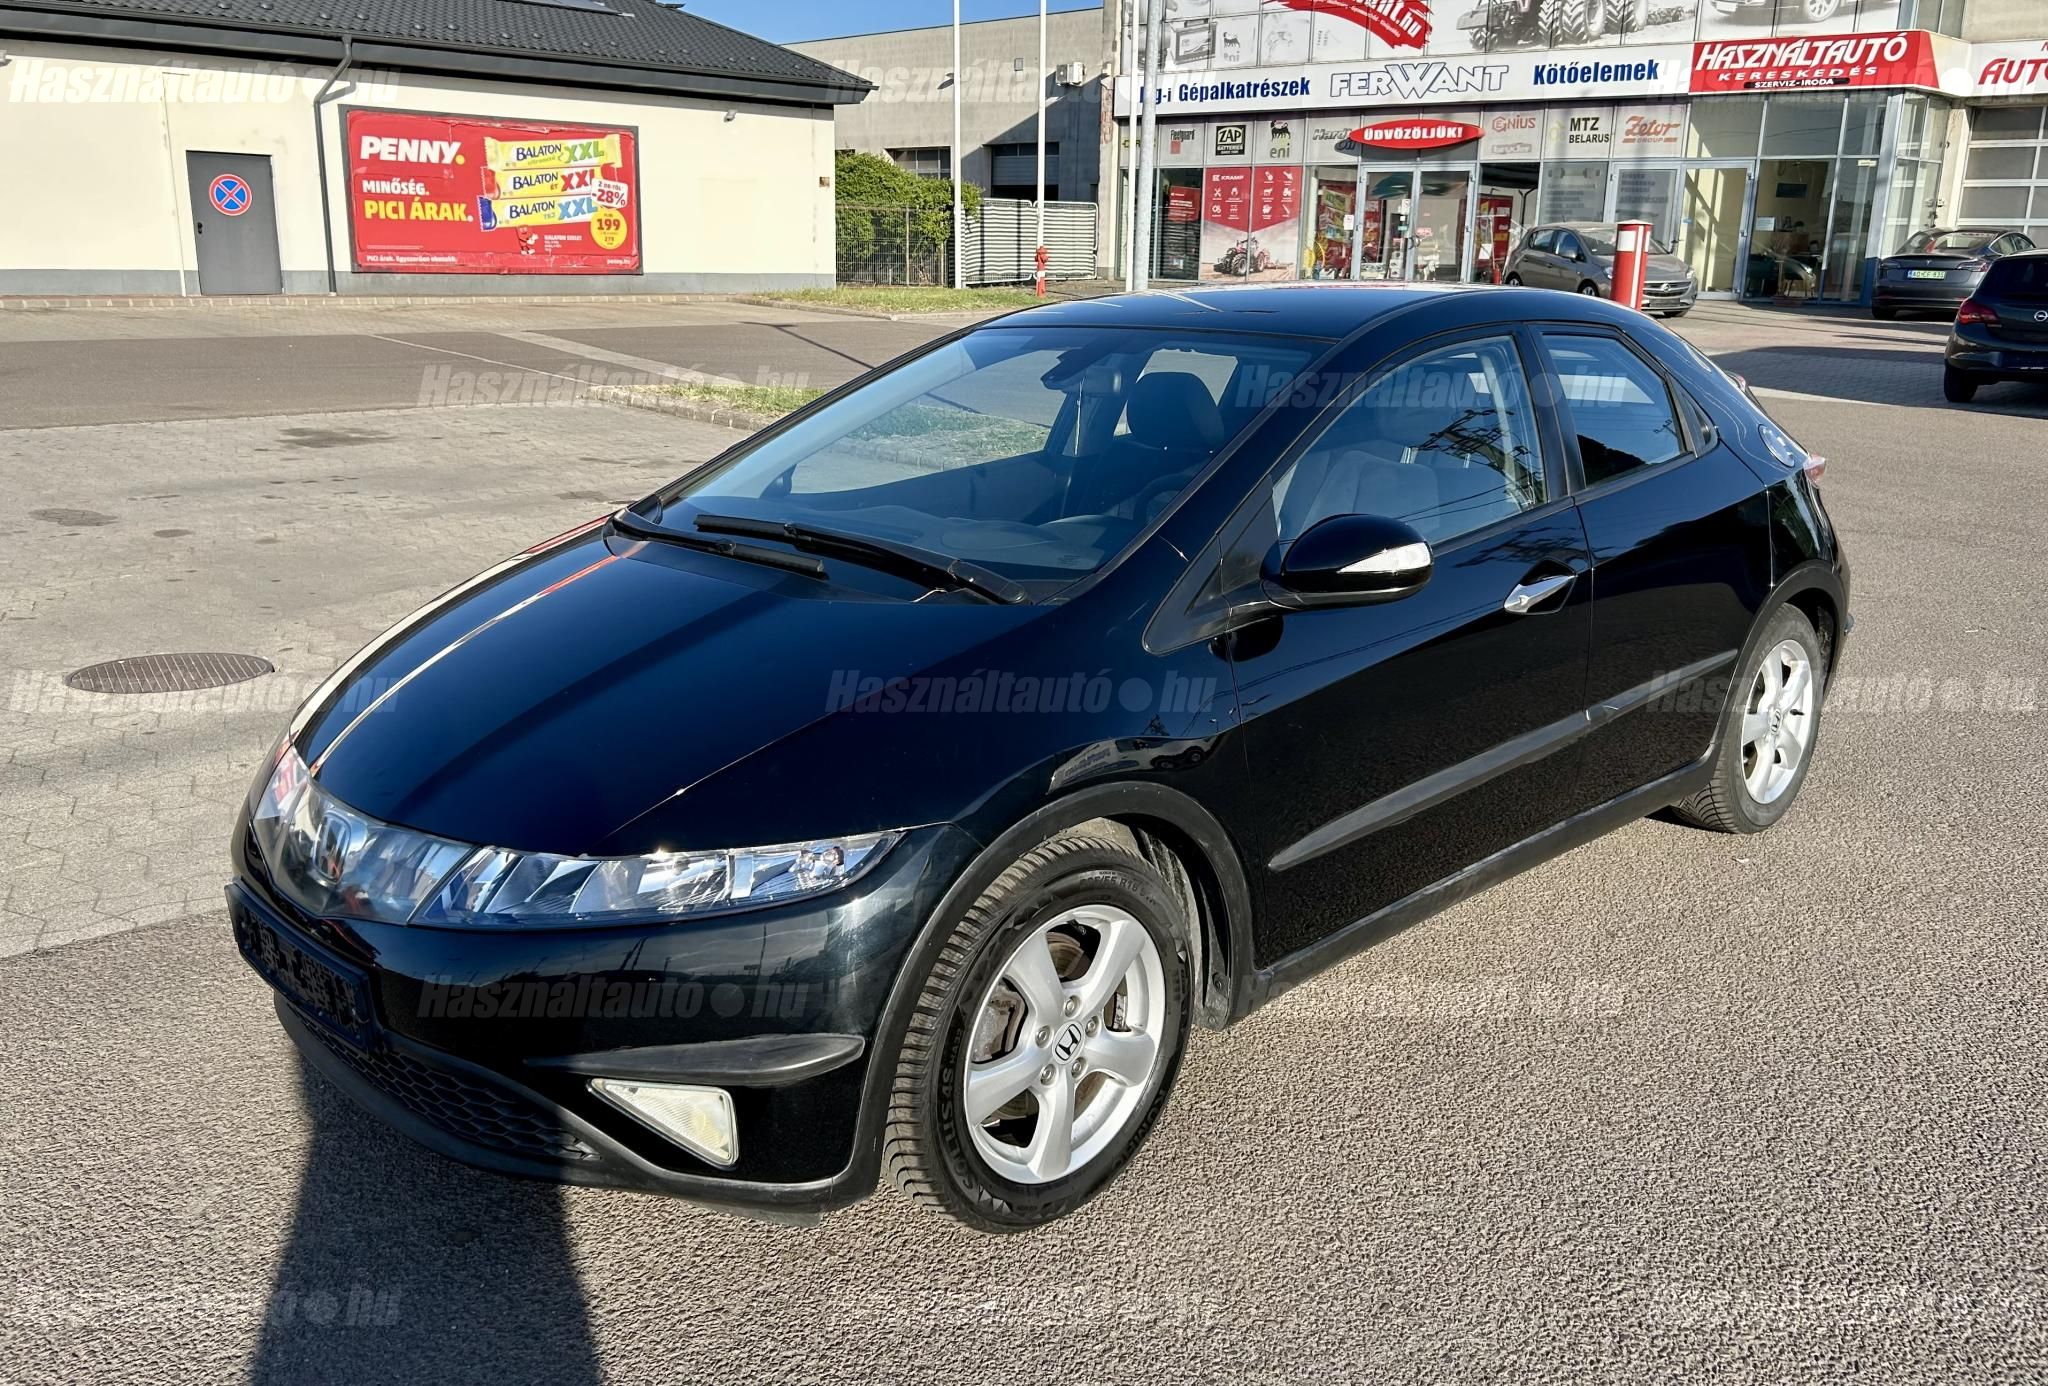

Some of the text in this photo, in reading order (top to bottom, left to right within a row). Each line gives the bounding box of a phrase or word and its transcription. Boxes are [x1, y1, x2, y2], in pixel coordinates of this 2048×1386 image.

[1695, 32, 1908, 71] HASZNÁLTAUTÓ
[1330, 62, 1510, 99] FERWANT
[1533, 59, 1660, 86] Kötőelemek
[1718, 66, 1878, 82] KERESKEDÉS
[1978, 58, 2048, 86] AUT
[1178, 76, 1311, 103] Gépalkatrészek
[1754, 78, 1835, 89] SZERVIZ-IRODA
[1569, 117, 1600, 131] MTZ
[1624, 115, 1681, 137] Zetor
[1219, 130, 1242, 144] ZAP
[1363, 127, 1463, 141] ÜDVÖZÖLJÜK!
[1568, 133, 1610, 144] BELARUS
[360, 135, 465, 165] PENNY.
[516, 144, 562, 162] BALATON
[564, 140, 605, 164] XXL
[1269, 143, 1290, 159] eni
[362, 177, 430, 196] MINŐSÉG.
[512, 172, 559, 190] BALATON
[592, 189, 626, 206] -28%
[364, 196, 474, 222] PICI ÁRAK.
[509, 197, 598, 221] BALATON XXL
[596, 218, 621, 231] 199
